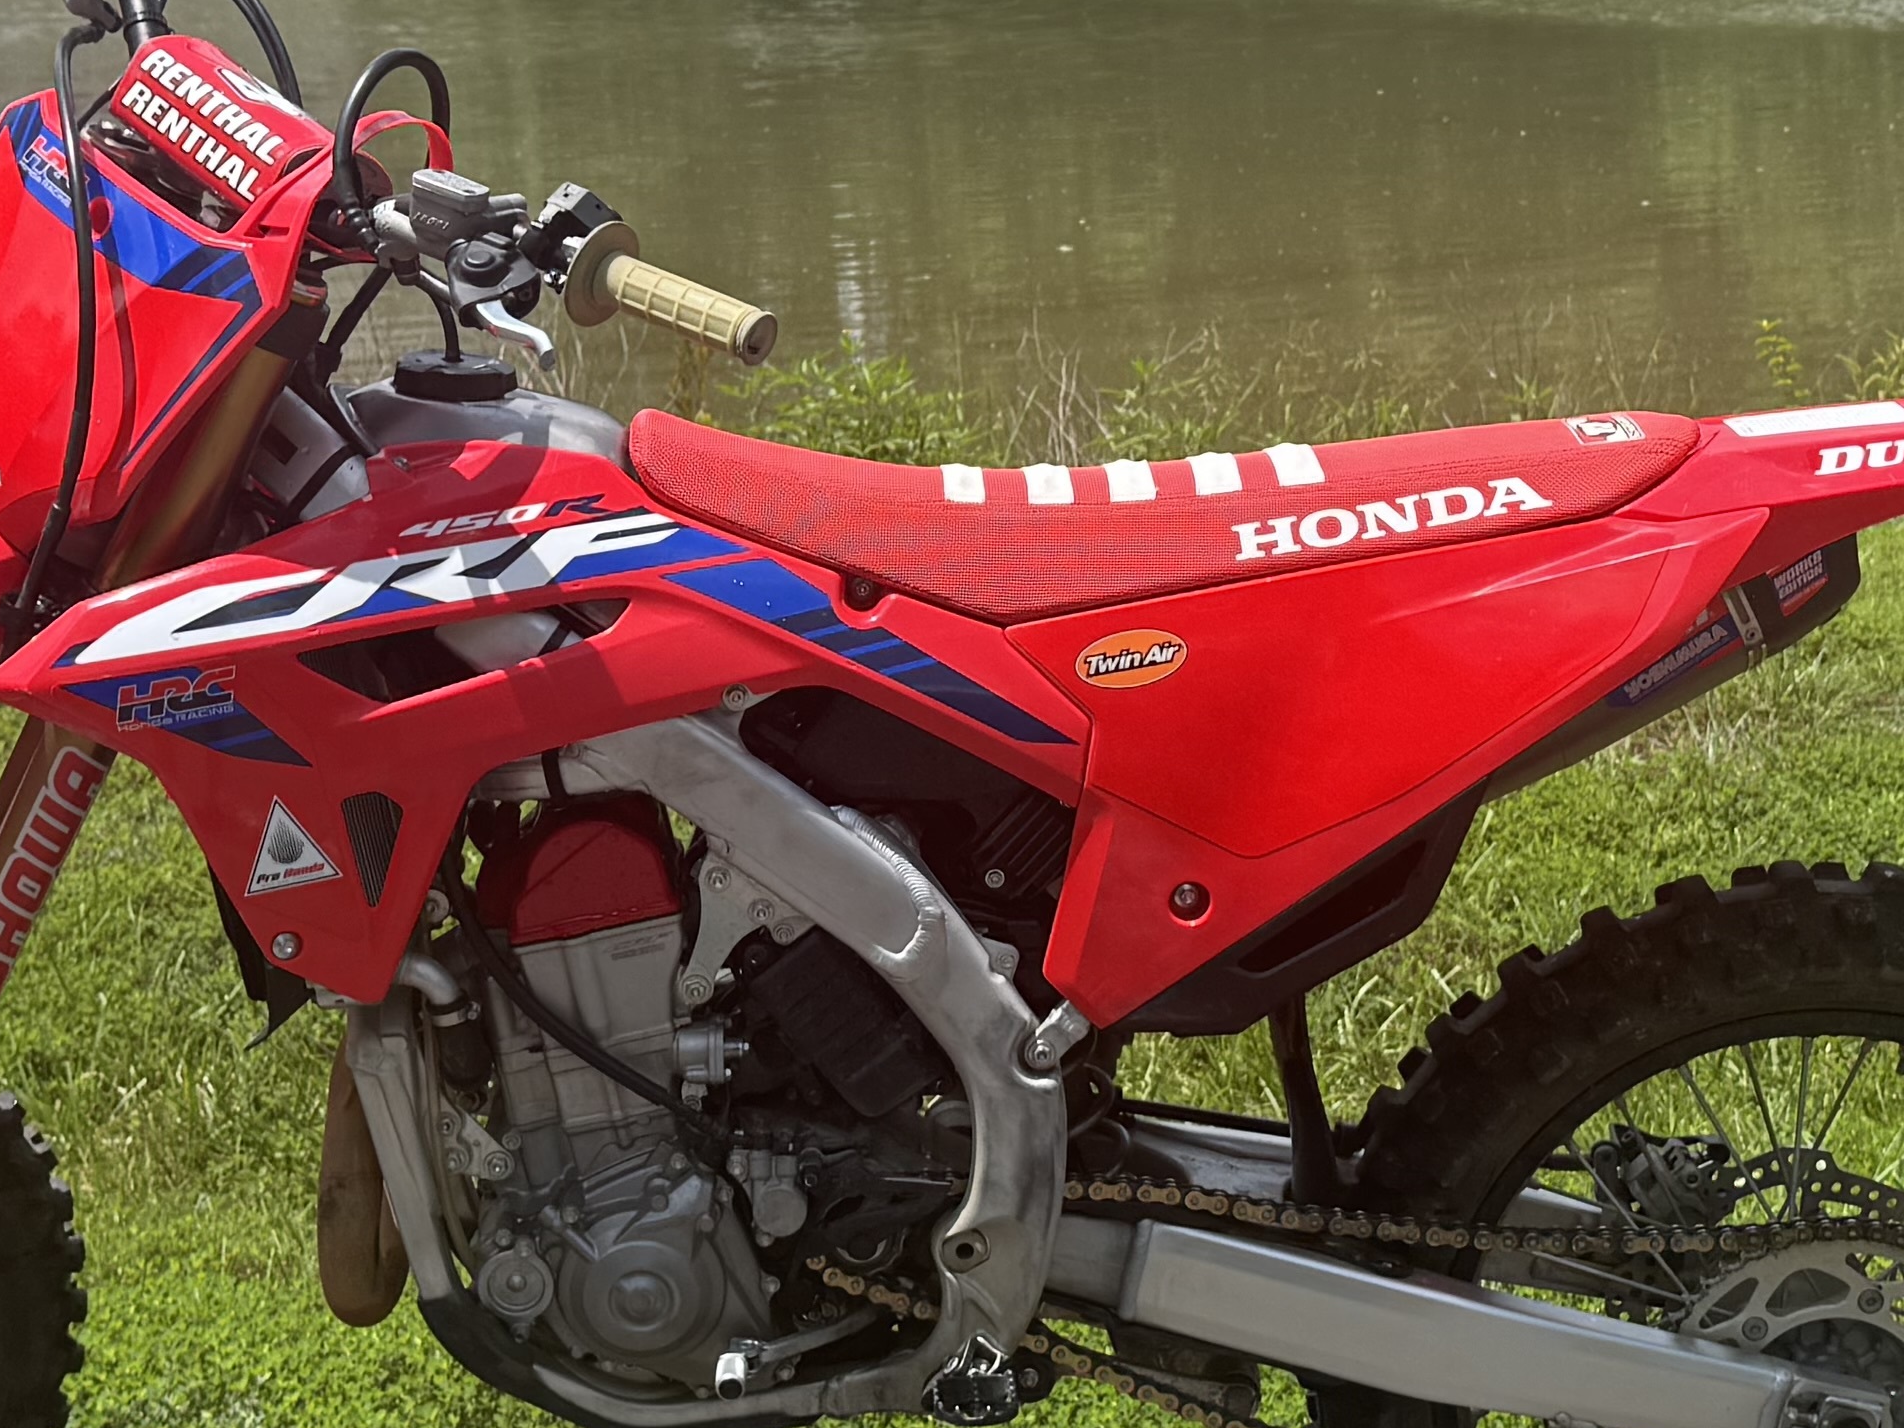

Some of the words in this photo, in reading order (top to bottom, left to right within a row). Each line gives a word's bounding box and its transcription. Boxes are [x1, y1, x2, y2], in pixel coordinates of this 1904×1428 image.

[140, 48, 284, 166] RENTHAL
[120, 79, 259, 203] RENTHAL
[1231, 476, 1552, 562] HONDA
[75, 512, 684, 665] CRF
[1778, 562, 1823, 600] EDITION
[1085, 649, 1142, 676] Twin
[1142, 641, 1180, 667] Air
[116, 665, 236, 725] HRC
[176, 704, 234, 723] RACING
[256, 872, 281, 885] Pro
